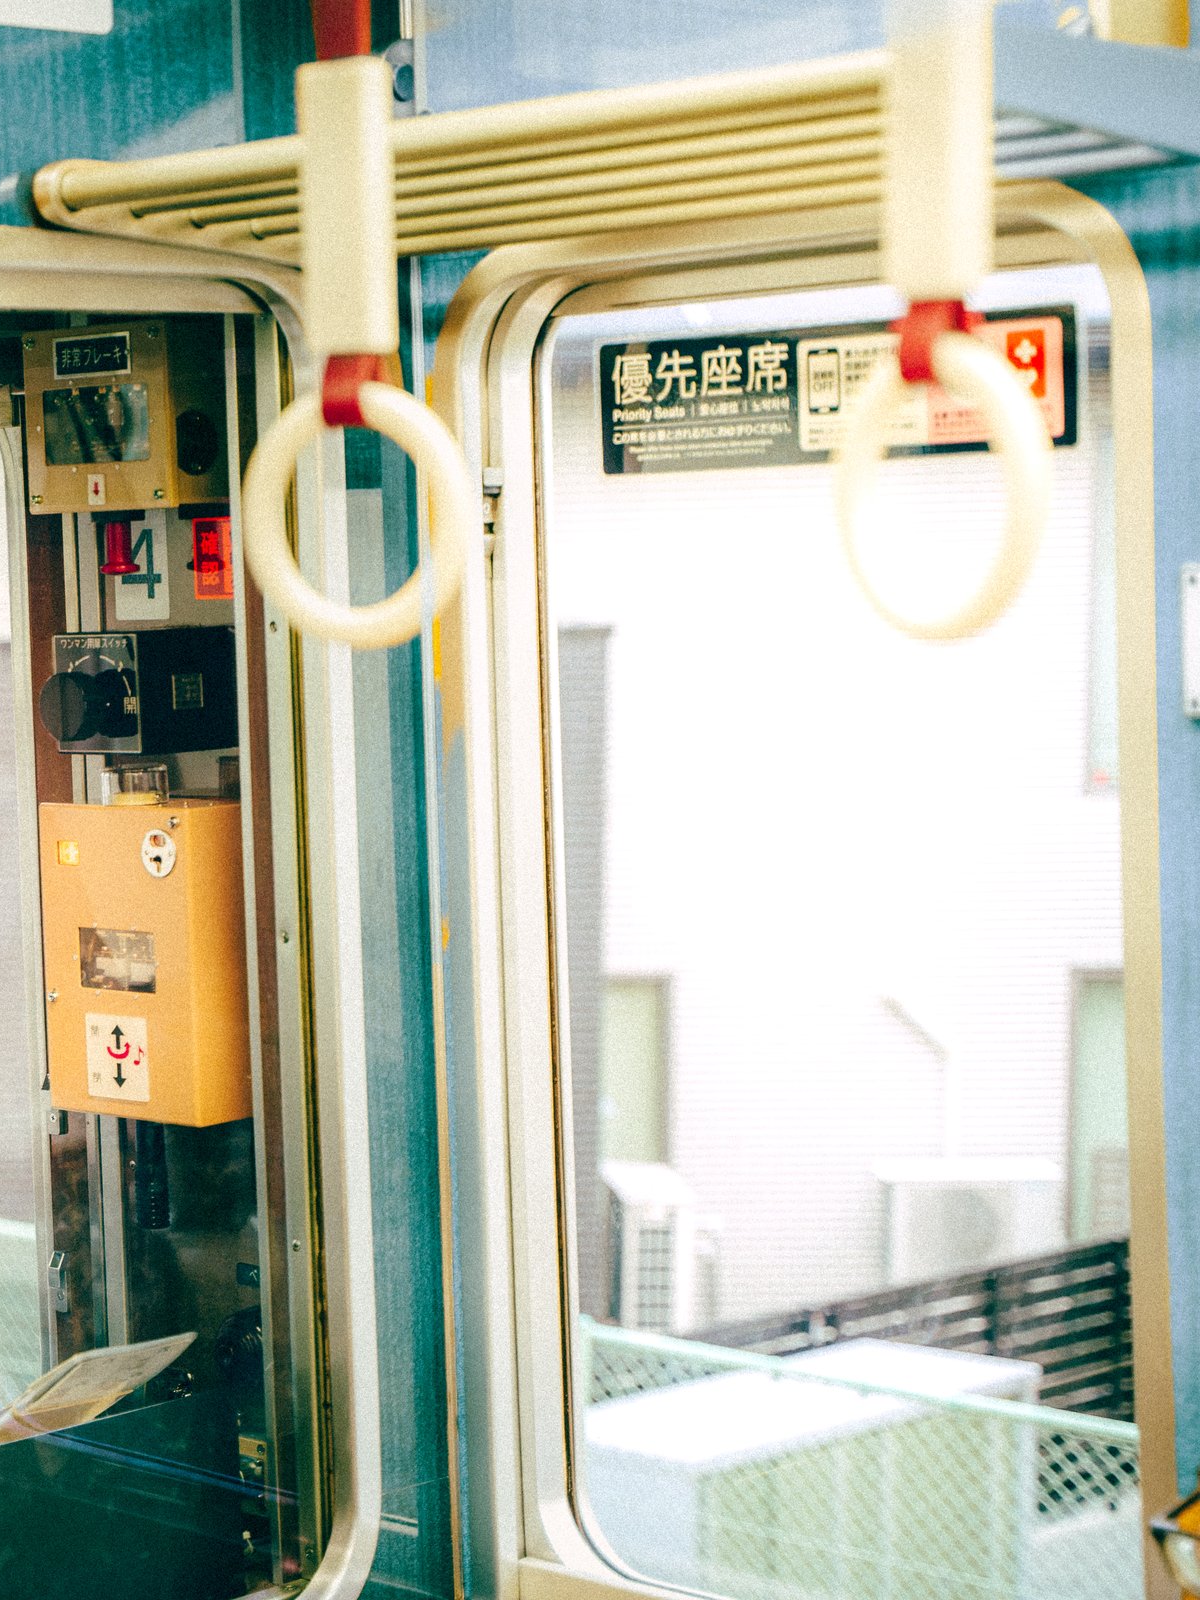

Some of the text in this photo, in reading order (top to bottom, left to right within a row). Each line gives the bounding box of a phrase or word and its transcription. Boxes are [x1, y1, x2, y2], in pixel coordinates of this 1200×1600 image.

[61, 345, 123, 368] 非常ブレーキ
[611, 339, 789, 406] 優先座席
[612, 405, 686, 423] Priority Seats
[121, 528, 162, 599] 4
